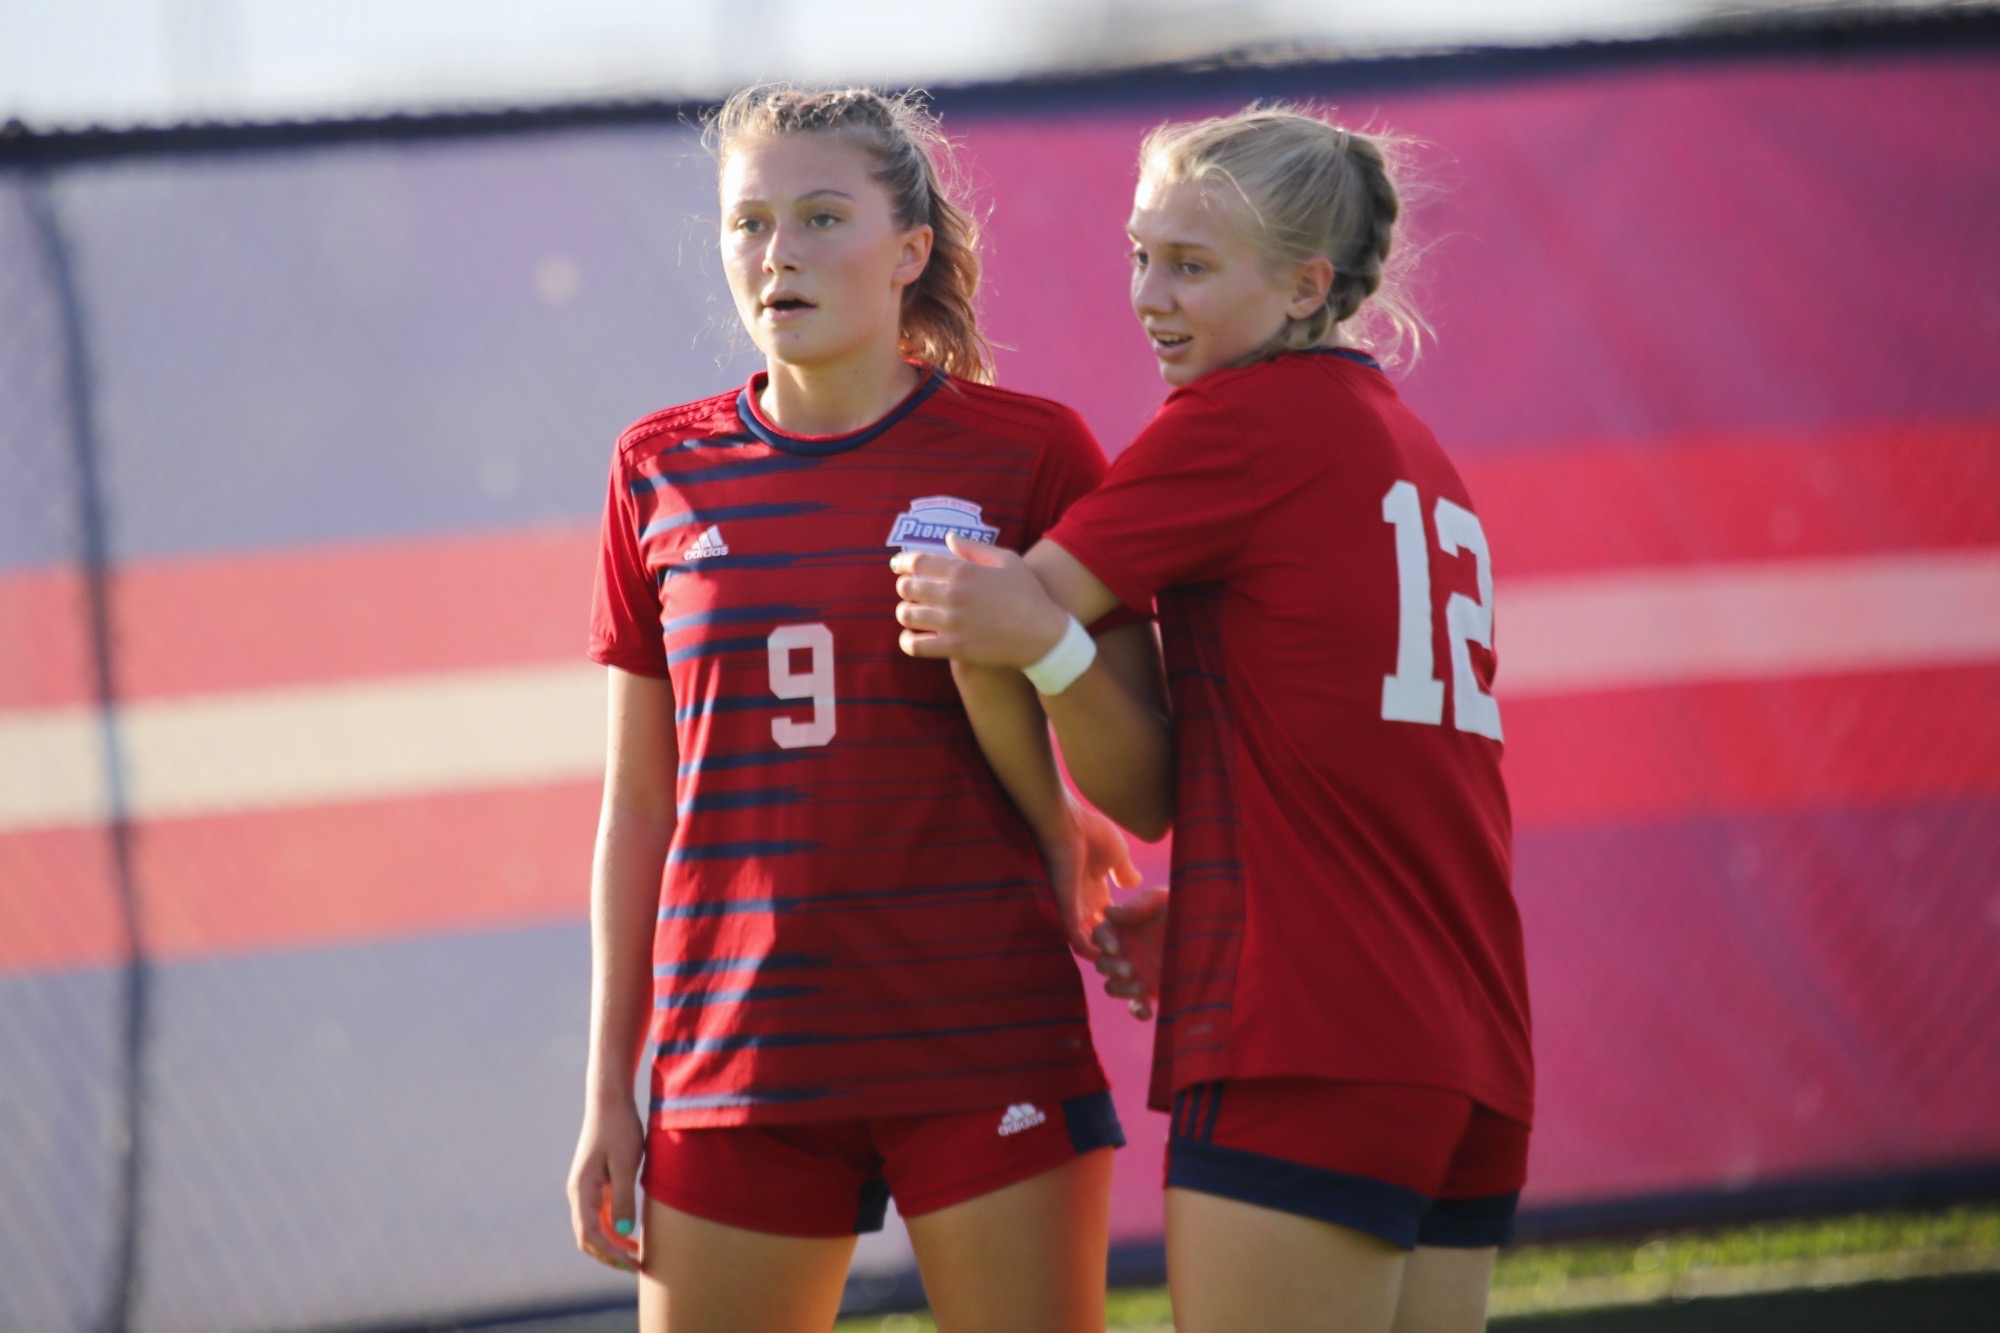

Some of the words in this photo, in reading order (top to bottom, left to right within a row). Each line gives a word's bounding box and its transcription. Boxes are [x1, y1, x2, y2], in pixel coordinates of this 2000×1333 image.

[684, 545, 729, 561] adidas
[1381, 479, 1504, 744] 12
[767, 623, 837, 749] 9
[998, 1111, 1046, 1137] adidas
